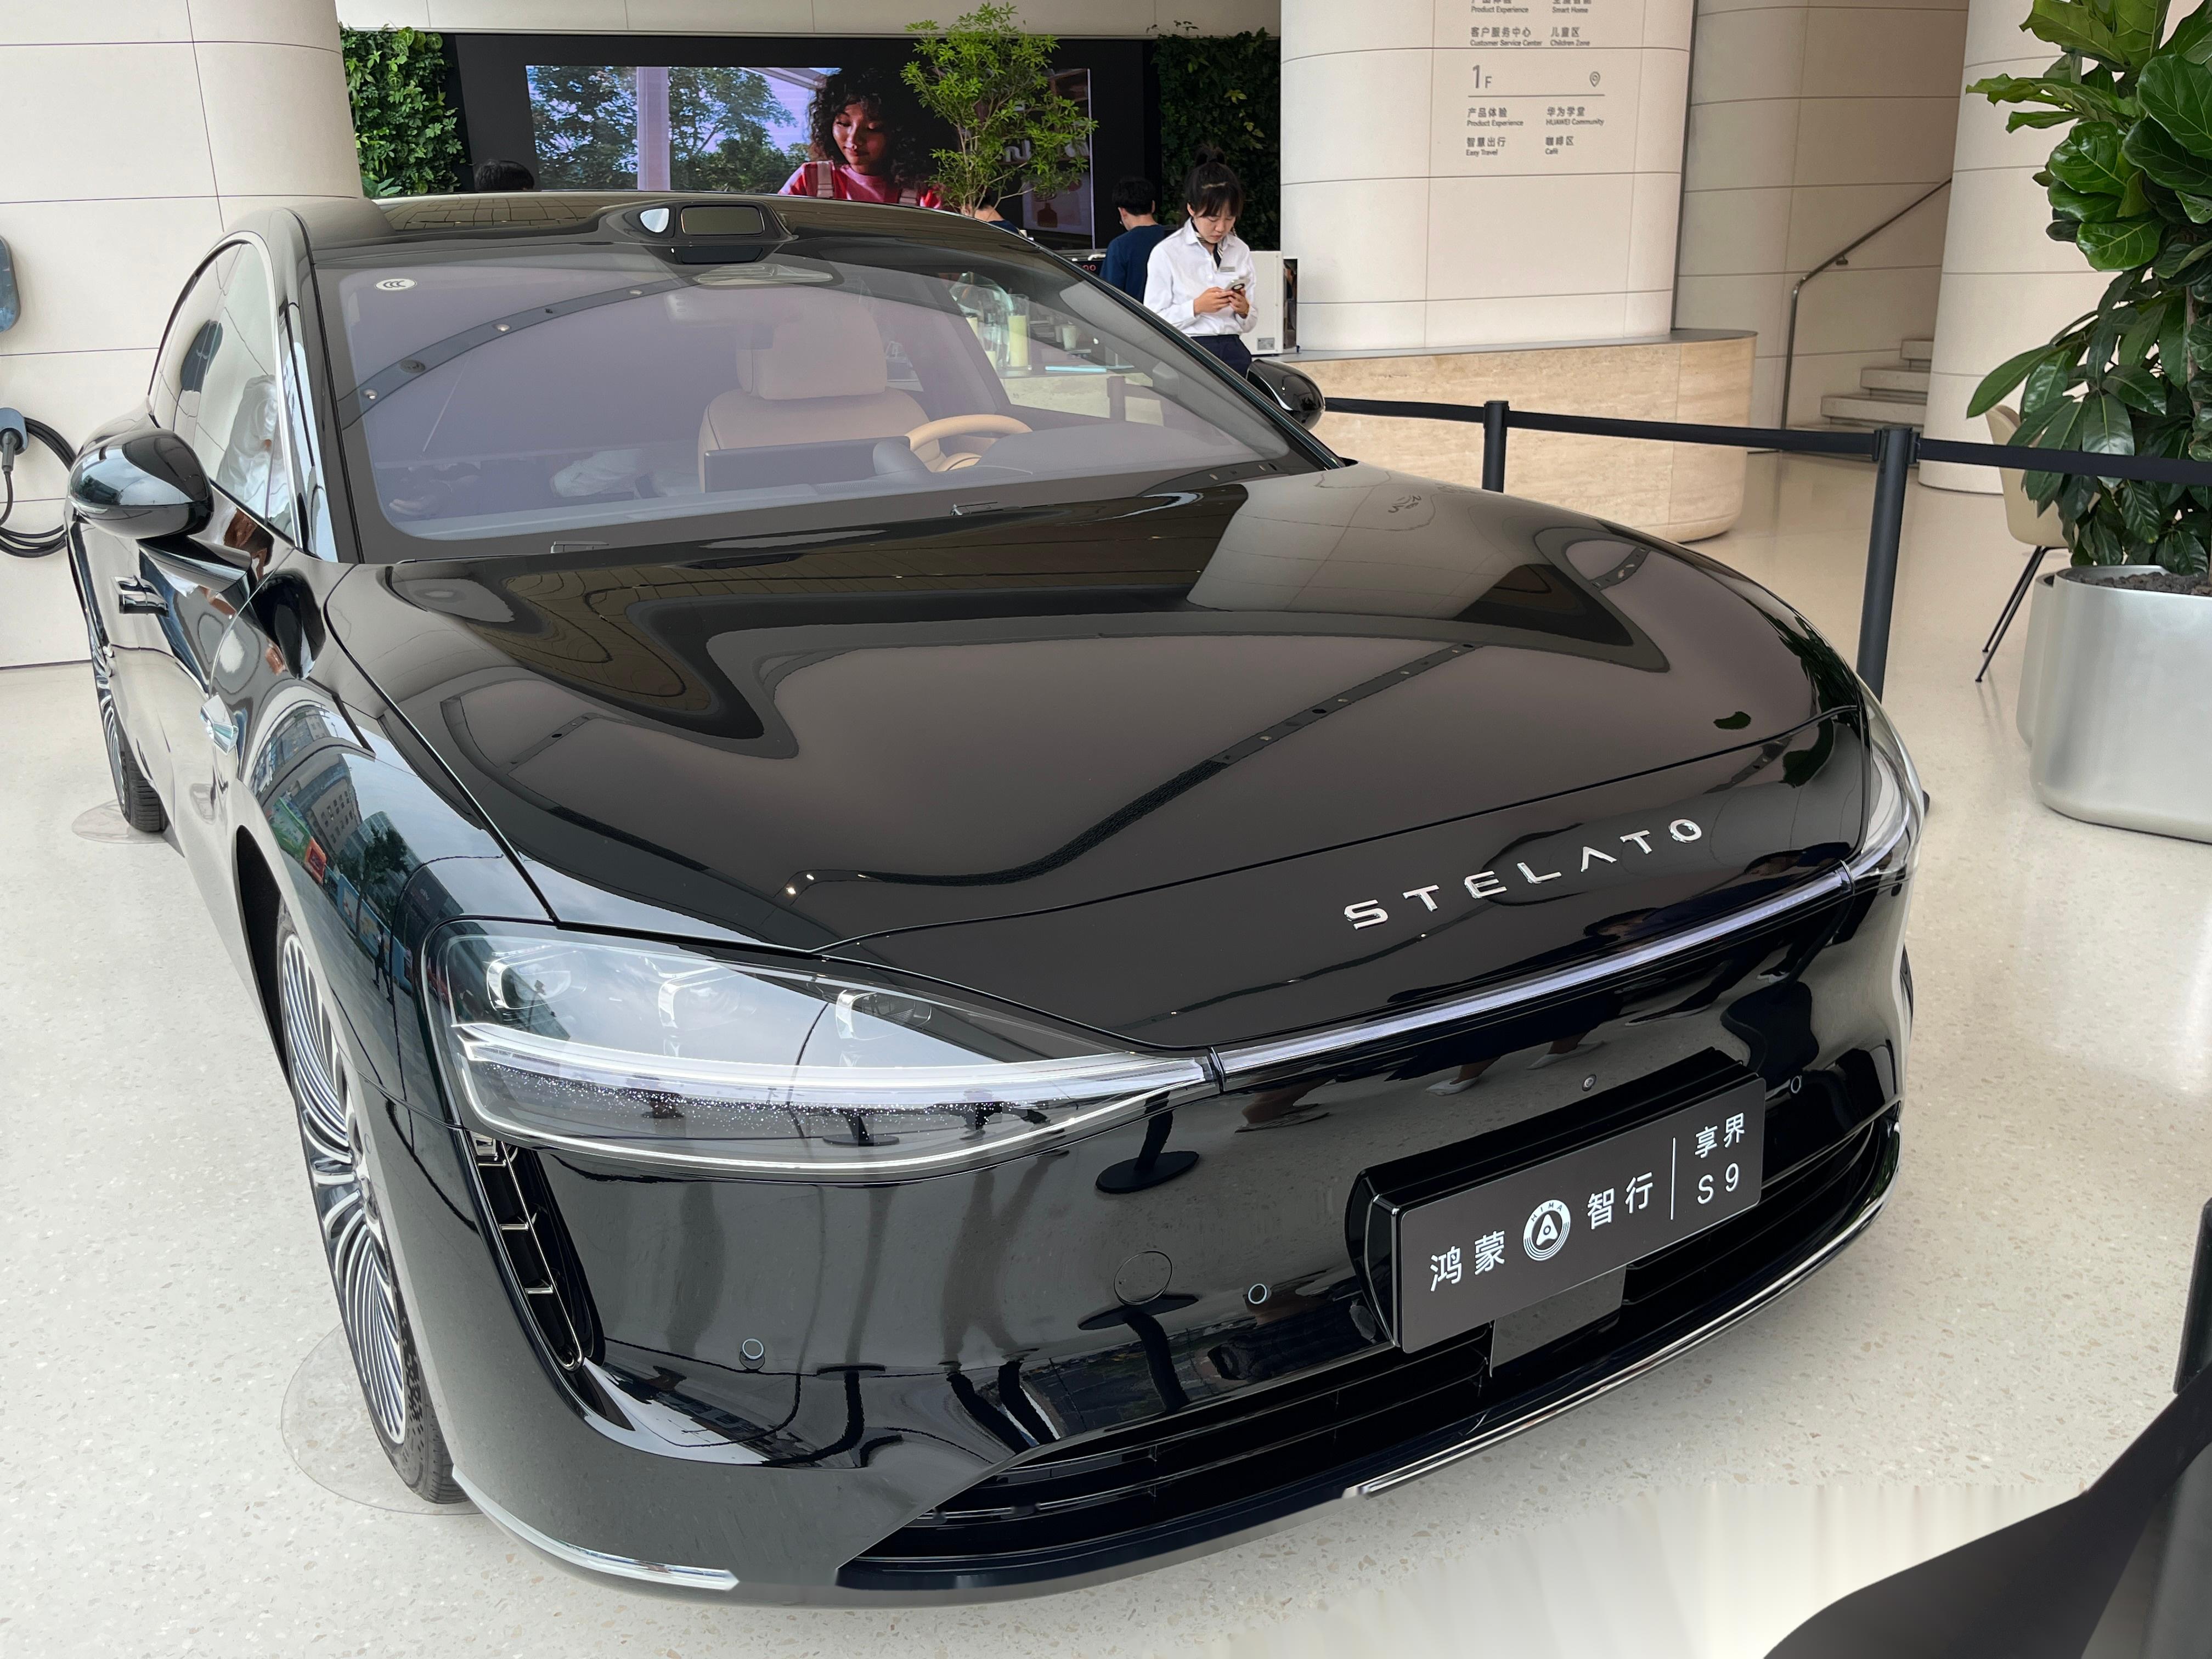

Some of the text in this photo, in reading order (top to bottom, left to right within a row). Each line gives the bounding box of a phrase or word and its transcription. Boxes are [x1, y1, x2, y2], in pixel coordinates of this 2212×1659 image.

[1496, 6, 1529, 14] Experience
[1471, 26, 1531, 38] 客户服务中心
[1551, 27, 1580, 37] 儿童区
[1468, 107, 1507, 118] 产品体验
[1492, 120, 1523, 128] Experience
[1466, 149, 1480, 157] Easy
[1344, 819, 1702, 930] STELATO
[1694, 1112, 1745, 1159] 享界
[1531, 1201, 1563, 1222] HIMA
[1429, 1171, 1654, 1293] 鸿蒙 智行
